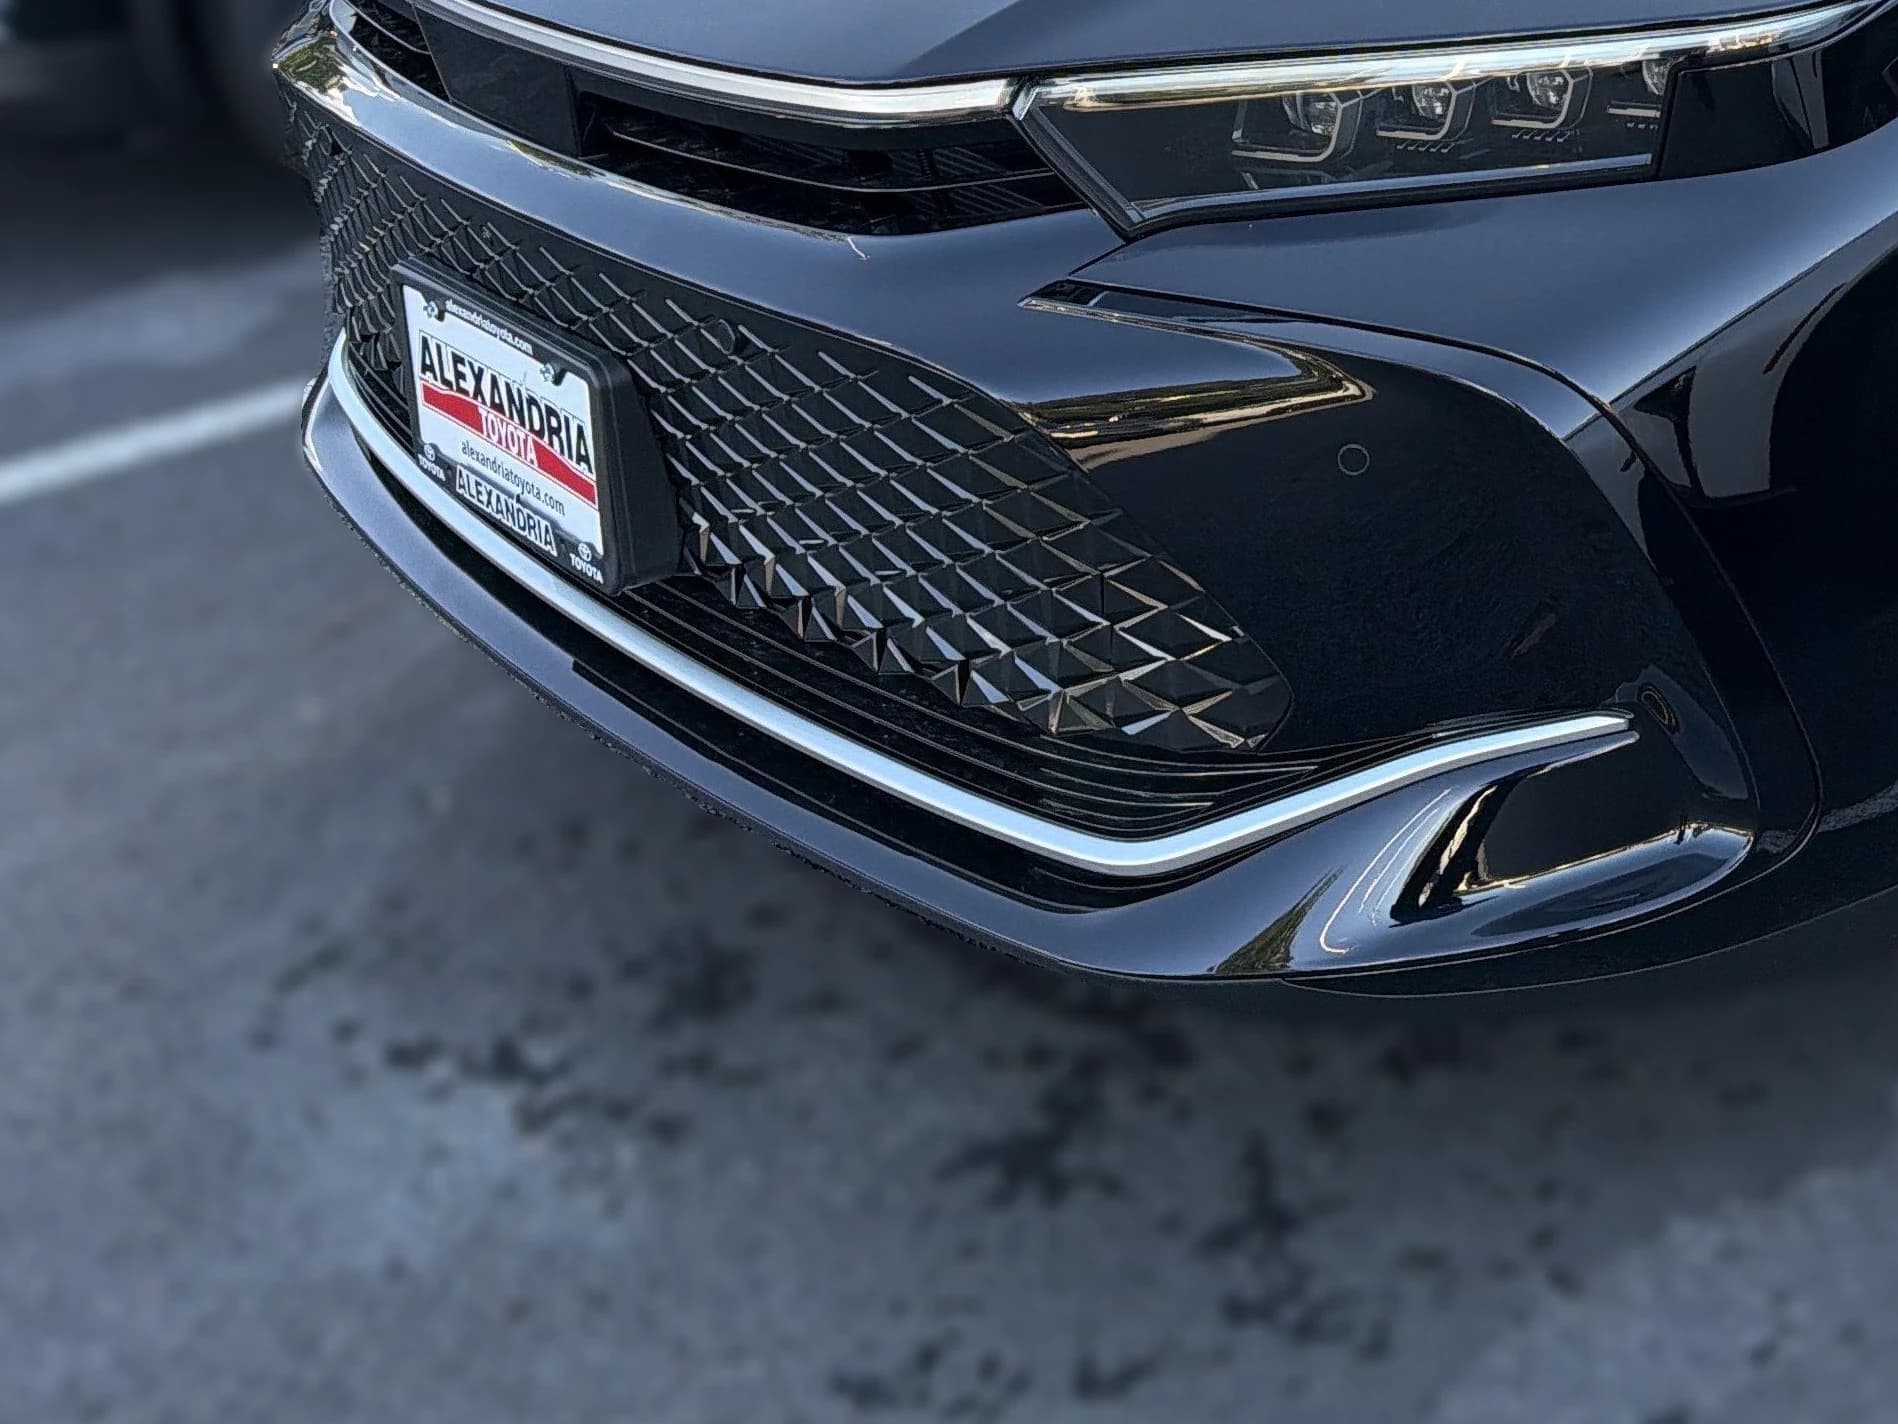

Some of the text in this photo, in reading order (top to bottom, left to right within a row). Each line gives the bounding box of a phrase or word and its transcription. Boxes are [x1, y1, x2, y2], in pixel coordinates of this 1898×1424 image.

[420, 334, 593, 475] ALEXANDRIA
[479, 408, 540, 468] TOYOTA
[418, 452, 604, 585] TOYOTA ALEXANDRIA TOYOTA
[461, 439, 566, 518] alexandriatoyota.com
